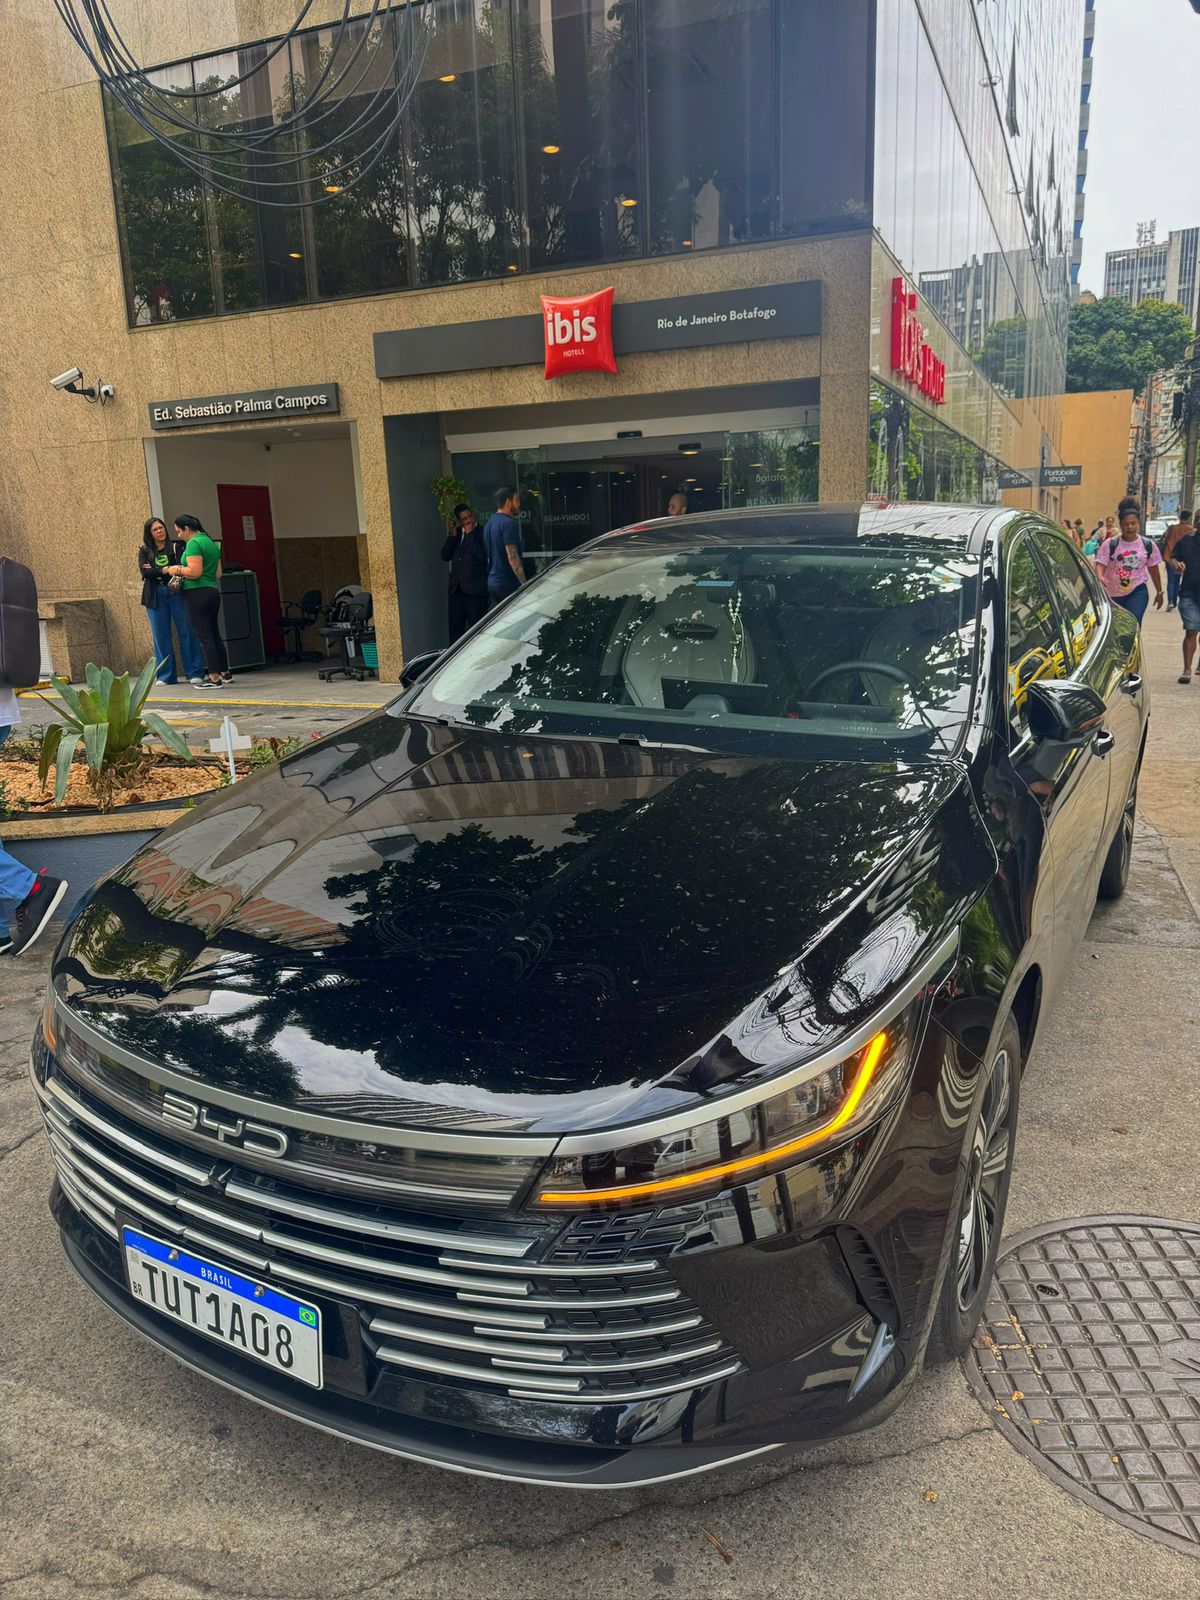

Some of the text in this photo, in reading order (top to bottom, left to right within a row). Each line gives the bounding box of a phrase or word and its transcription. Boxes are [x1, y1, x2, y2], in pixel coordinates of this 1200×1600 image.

[547, 308, 598, 346] ibis
[657, 306, 777, 329] Rio de Janeiro Botafogo
[563, 348, 585, 358] HOTELS
[153, 394, 328, 421] Ed. Sebastião Palma Campos
[1044, 468, 1078, 477] Portobello
[1049, 475, 1067, 483] shop
[162, 1091, 288, 1158] BYD
[132, 1280, 144, 1297] BR
[201, 1267, 233, 1289] BRASIL
[141, 1260, 294, 1368] TUT1A08
